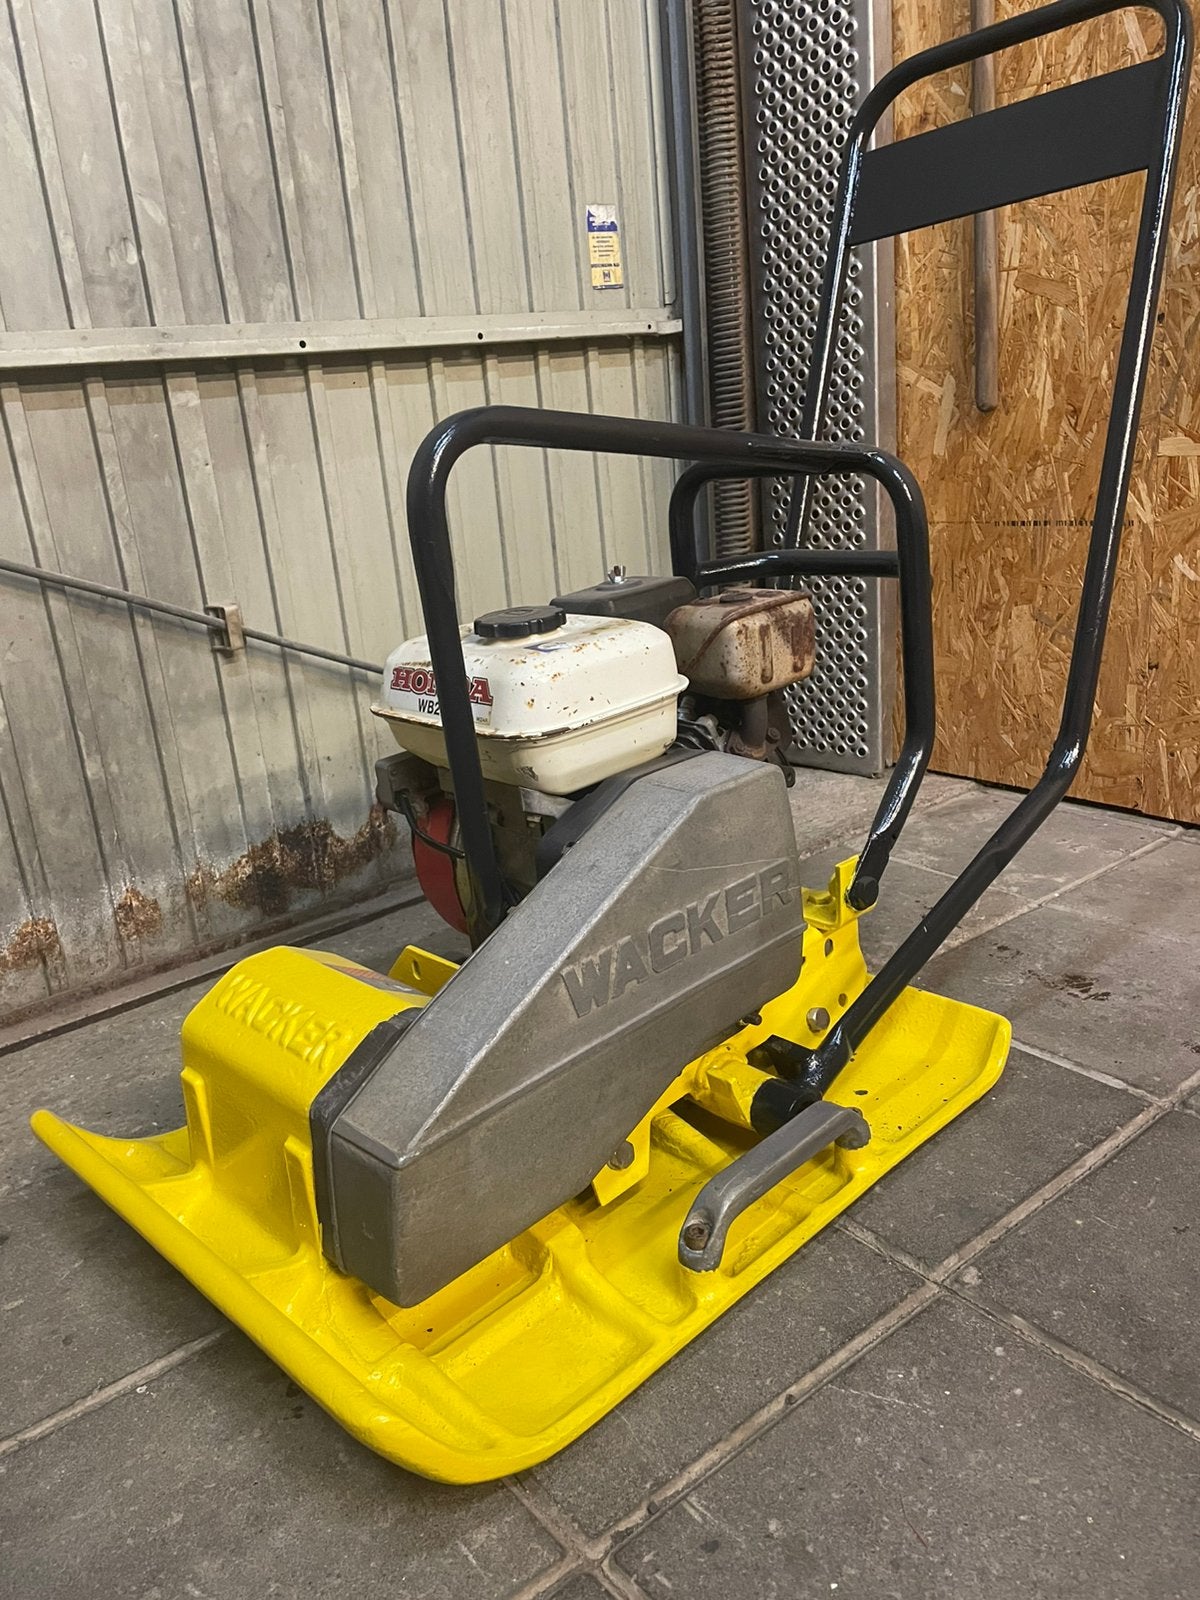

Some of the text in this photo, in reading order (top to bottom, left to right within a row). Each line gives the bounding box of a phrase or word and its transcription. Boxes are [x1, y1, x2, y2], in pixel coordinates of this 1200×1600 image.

[391, 666, 493, 706] HOA
[560, 857, 793, 1019] WACKER
[215, 974, 342, 1071] WACKER
